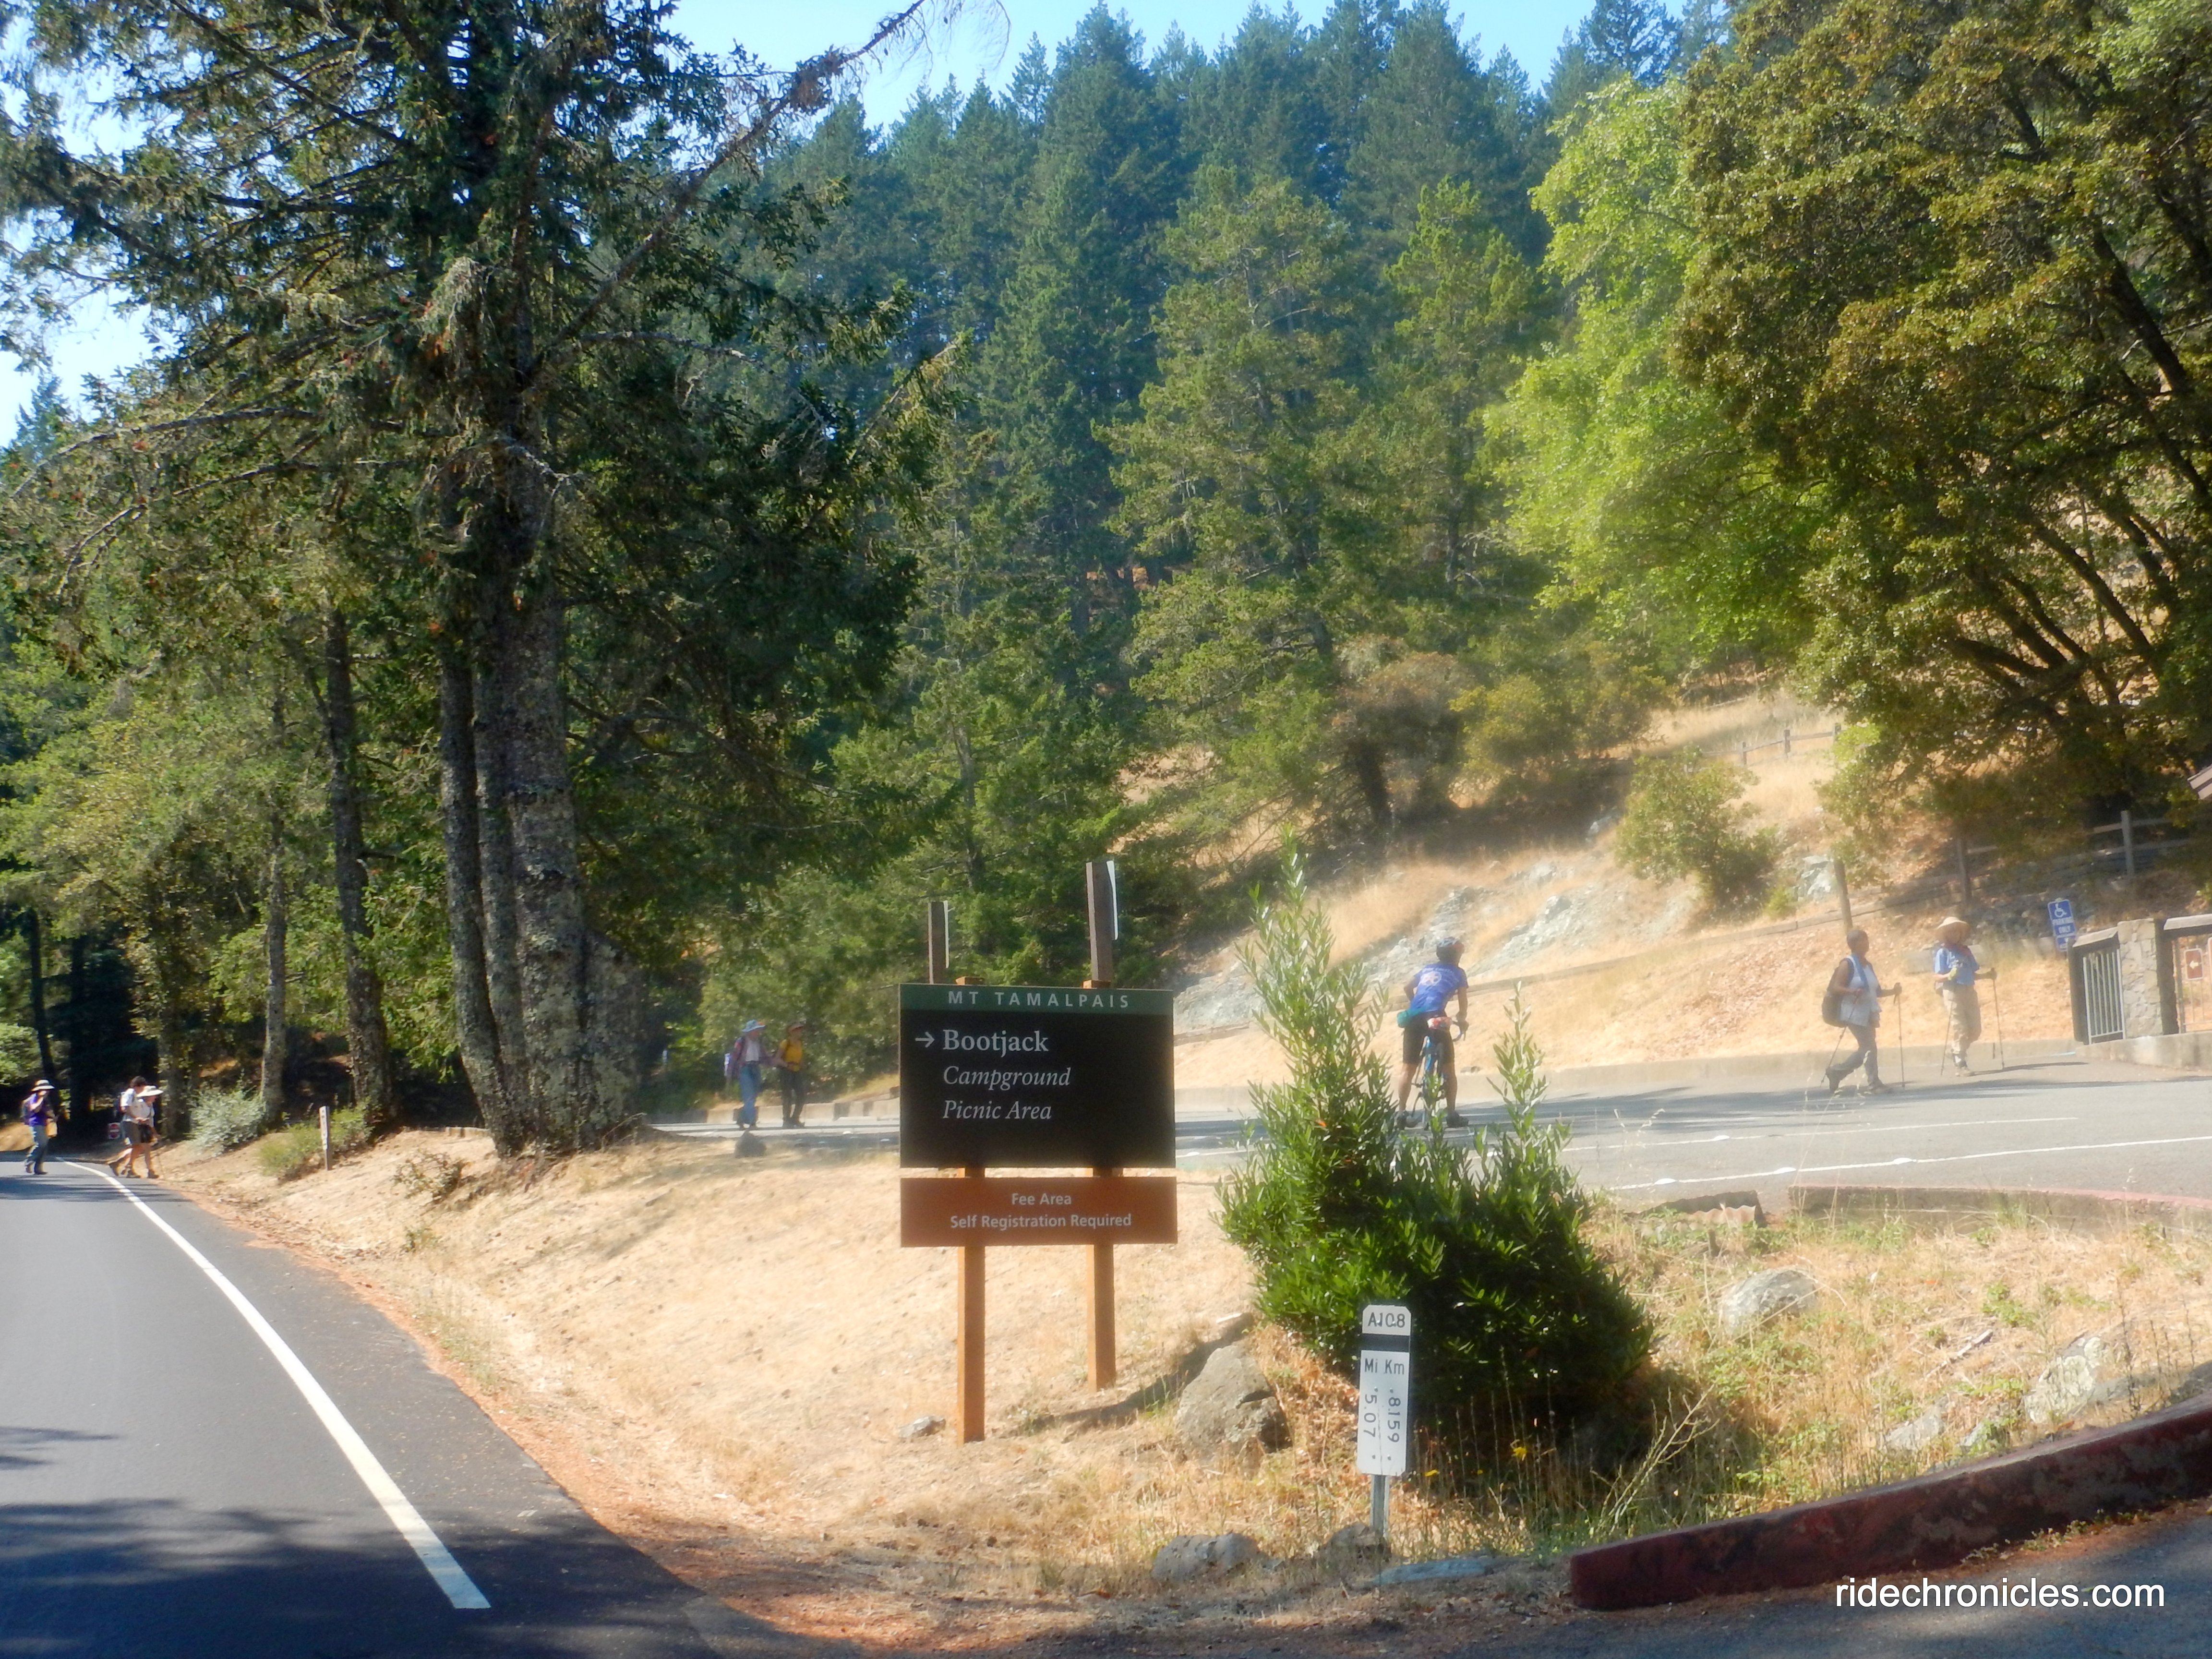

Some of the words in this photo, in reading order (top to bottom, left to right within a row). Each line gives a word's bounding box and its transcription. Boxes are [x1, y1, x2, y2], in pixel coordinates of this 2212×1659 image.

[948, 991, 979, 1004] MT
[995, 992, 1129, 1008] TAMALPAIS
[942, 1029, 1049, 1058] Bootjack
[943, 1065, 1071, 1091] Campground
[942, 1100, 1002, 1119] Picnic
[1006, 1101, 1052, 1120] Area
[1011, 1193, 1035, 1205] Fee
[1039, 1192, 1072, 1205] Area
[950, 1215, 977, 1228] Self
[981, 1214, 1066, 1231] Registration
[1071, 1214, 1131, 1228] Required
[1364, 1358, 1378, 1373] Mi
[1384, 1359, 1405, 1375] Km
